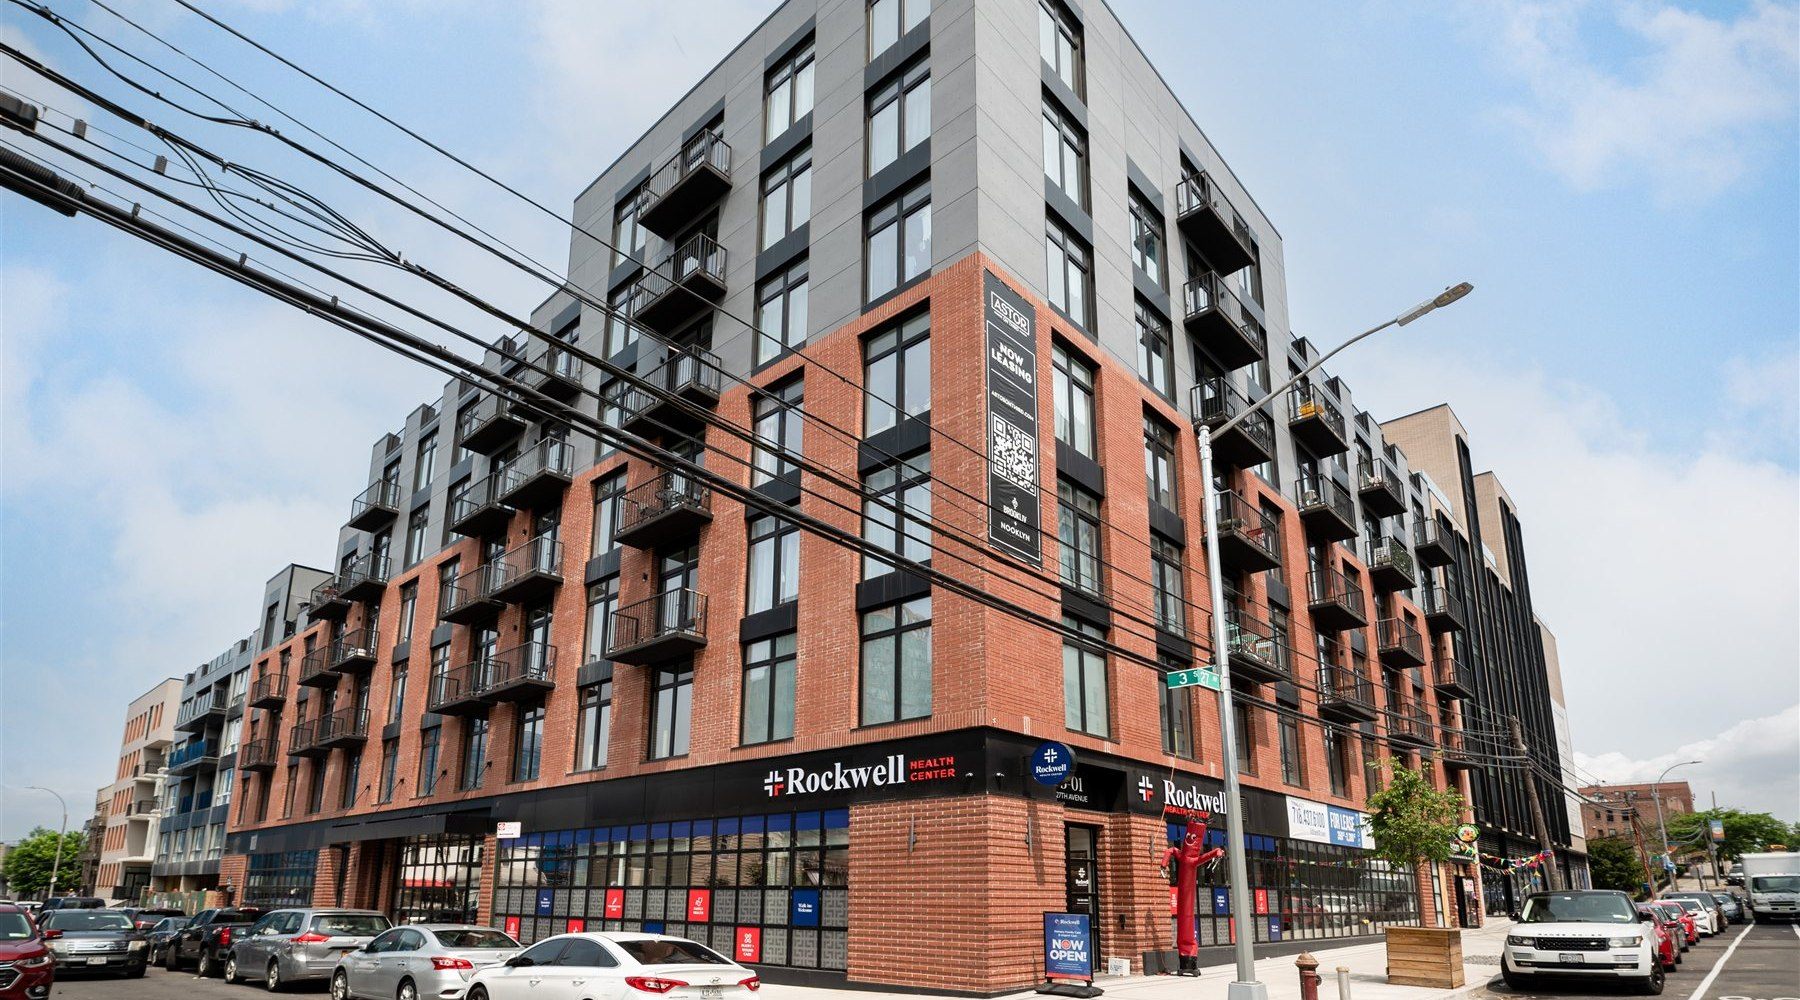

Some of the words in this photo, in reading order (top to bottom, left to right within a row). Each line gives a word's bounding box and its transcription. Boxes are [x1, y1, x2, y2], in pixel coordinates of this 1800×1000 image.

[994, 299, 1027, 331] ASTOR
[1000, 342, 1024, 366] NOW
[992, 348, 1032, 384] LEASING
[1000, 521, 1030, 542] NOOKLYN
[1178, 672, 1188, 685] 3
[1200, 671, 1209, 686] 27
[786, 754, 906, 795] Rockwell
[909, 756, 954, 770] HEALTH
[909, 768, 955, 782] CENTER
[1035, 763, 1067, 774] Rockwell
[1056, 791, 1068, 800] 27TH
[1068, 793, 1088, 803] AVENUE
[1163, 779, 1227, 815] Rockwell
[1165, 805, 1187, 816] HEALTH
[1329, 811, 1340, 829] FOR
[1340, 814, 1356, 832] LEASE
[1052, 938, 1084, 951] NOW
[1049, 949, 1088, 963] OPEN!
